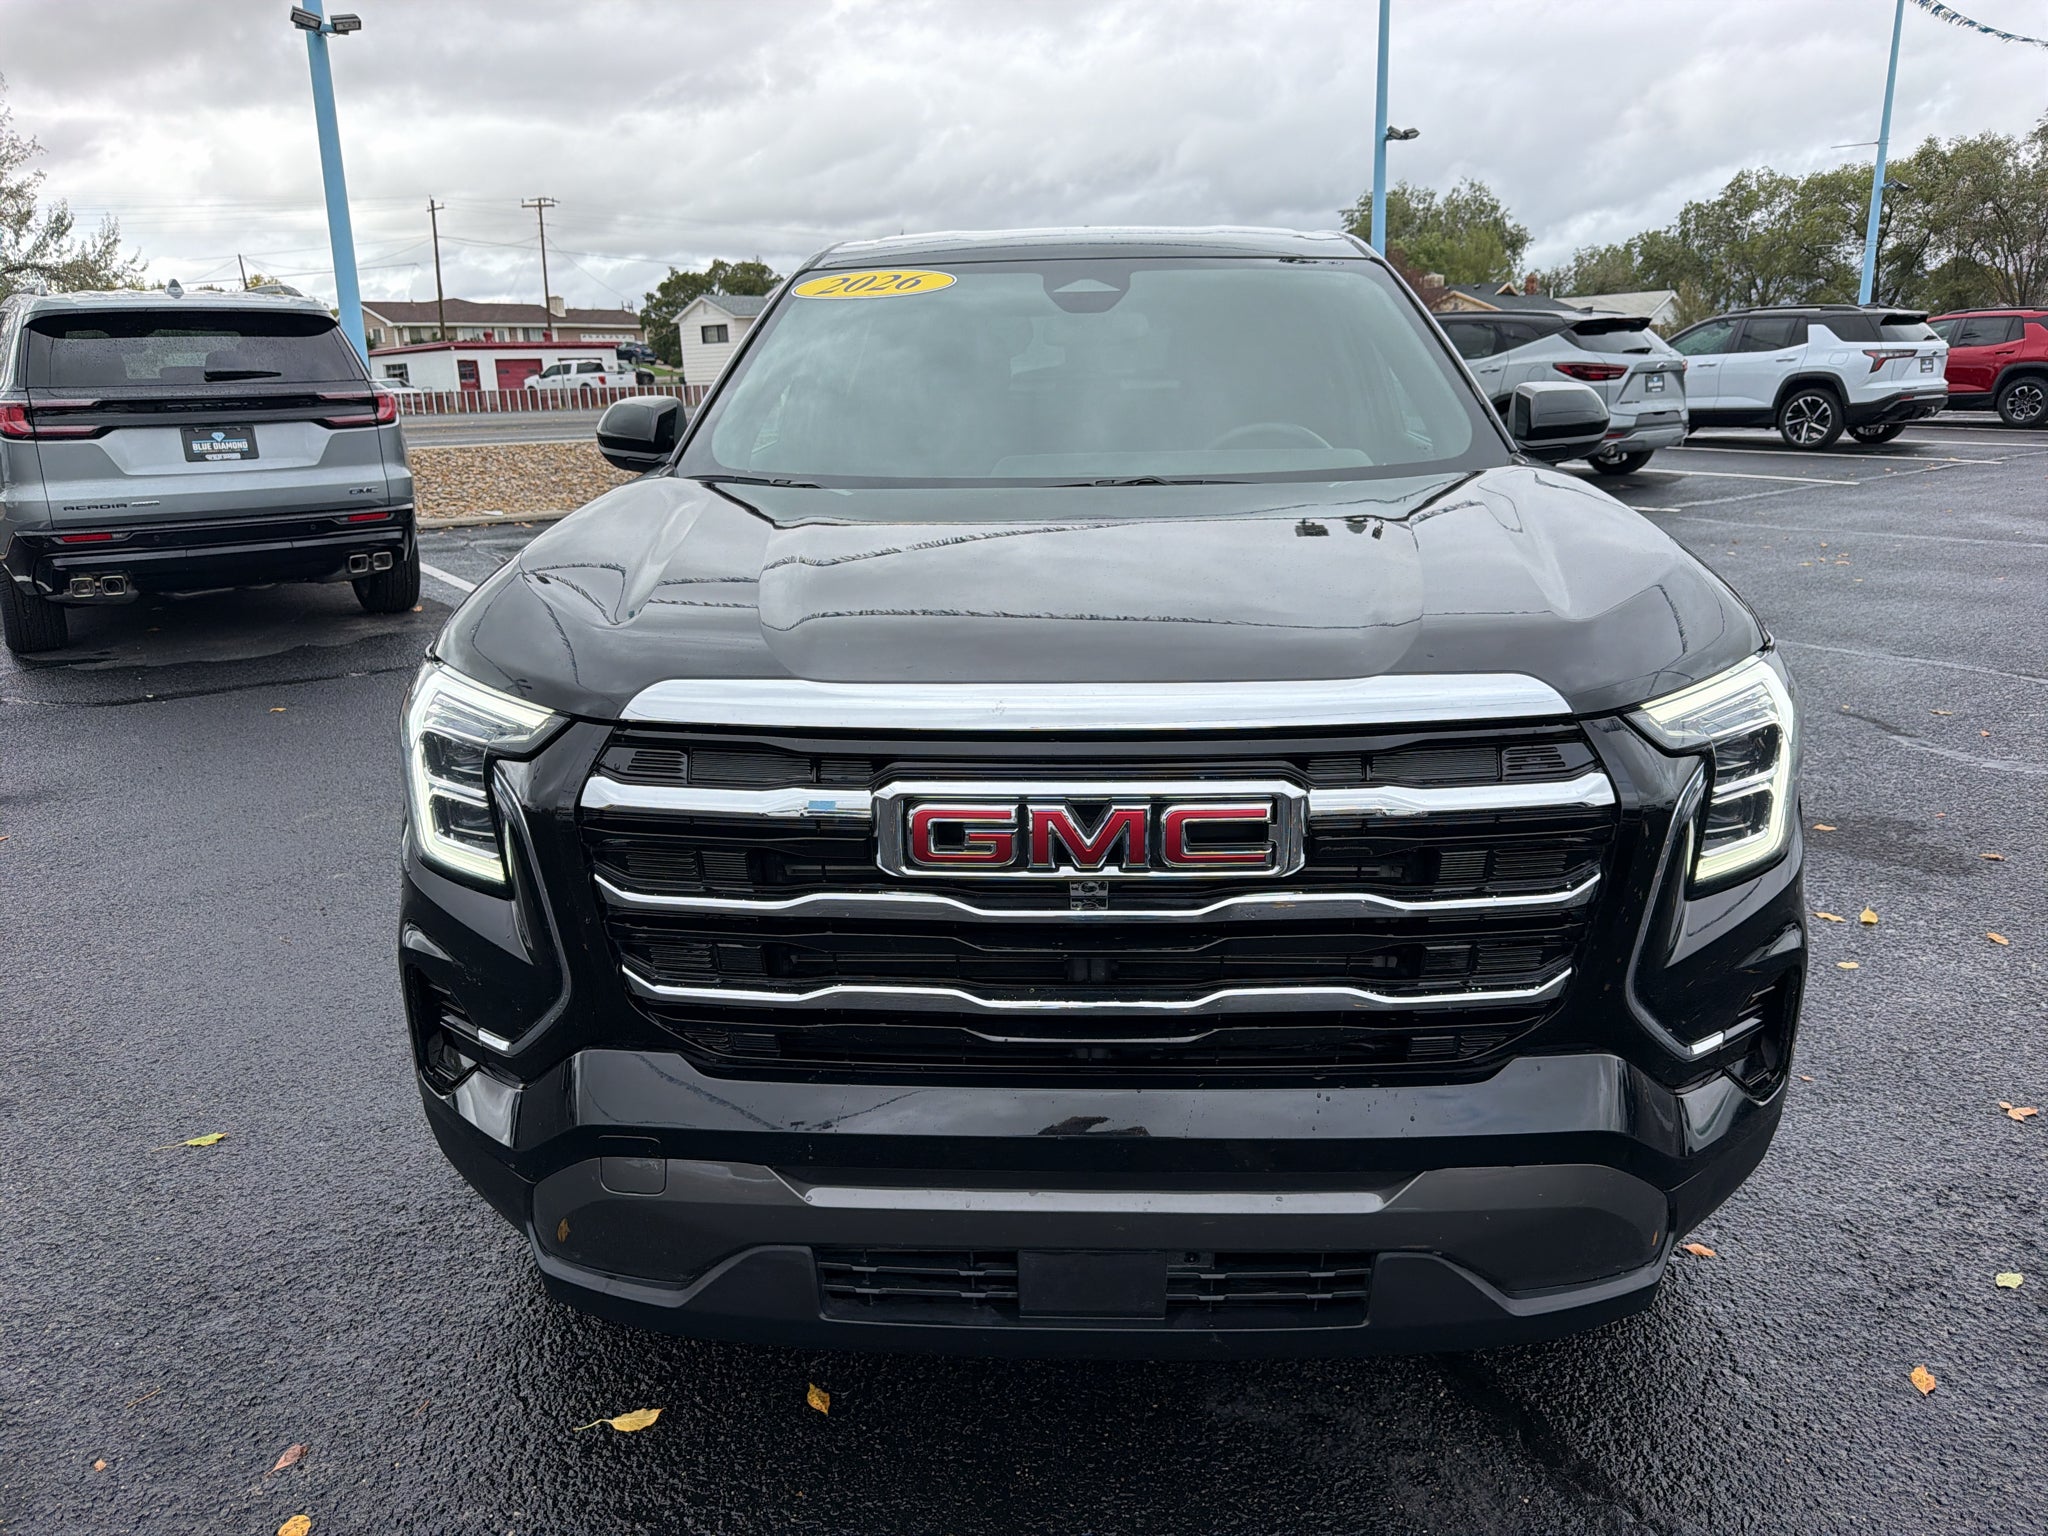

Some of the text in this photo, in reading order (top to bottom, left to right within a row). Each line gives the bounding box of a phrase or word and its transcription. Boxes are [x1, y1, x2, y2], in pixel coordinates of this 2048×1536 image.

[814, 274, 931, 295] 2026
[192, 443, 212, 451] BLUE
[213, 441, 248, 450] DIAMOND
[63, 503, 128, 511] ACADIA
[908, 803, 1275, 870] GMC
